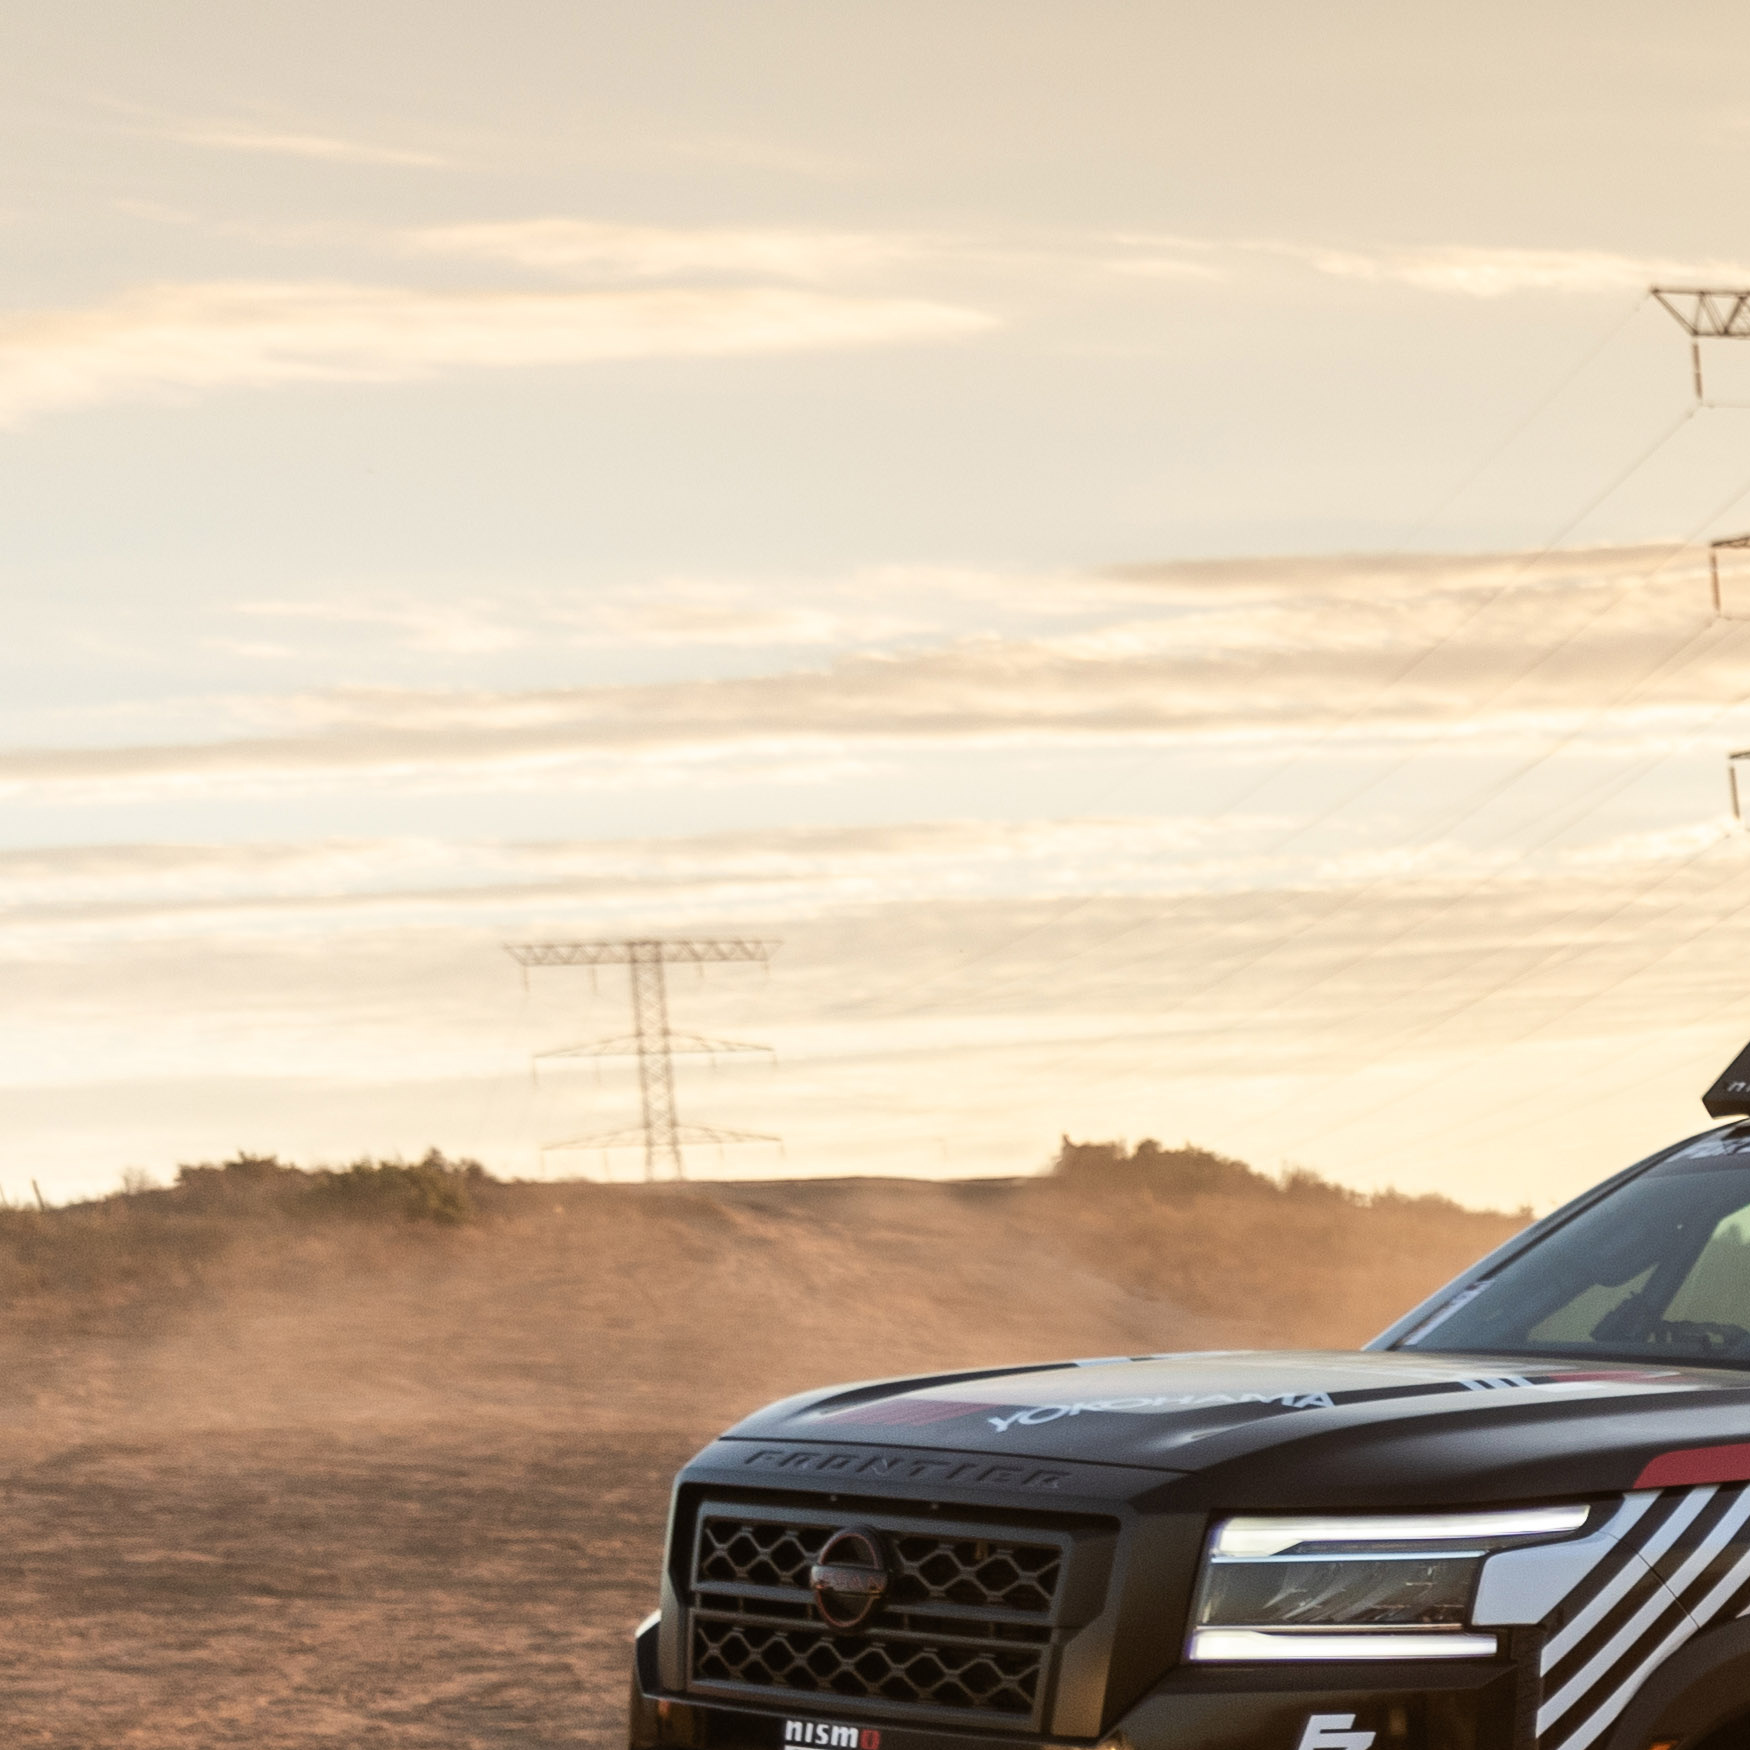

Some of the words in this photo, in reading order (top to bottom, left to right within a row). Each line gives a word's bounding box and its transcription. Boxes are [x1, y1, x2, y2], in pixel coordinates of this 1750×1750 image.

[987, 1391, 1335, 1434] YOKOHAMA
[744, 1450, 1073, 1490] FRONTIER
[785, 1719, 881, 1750] nismo
